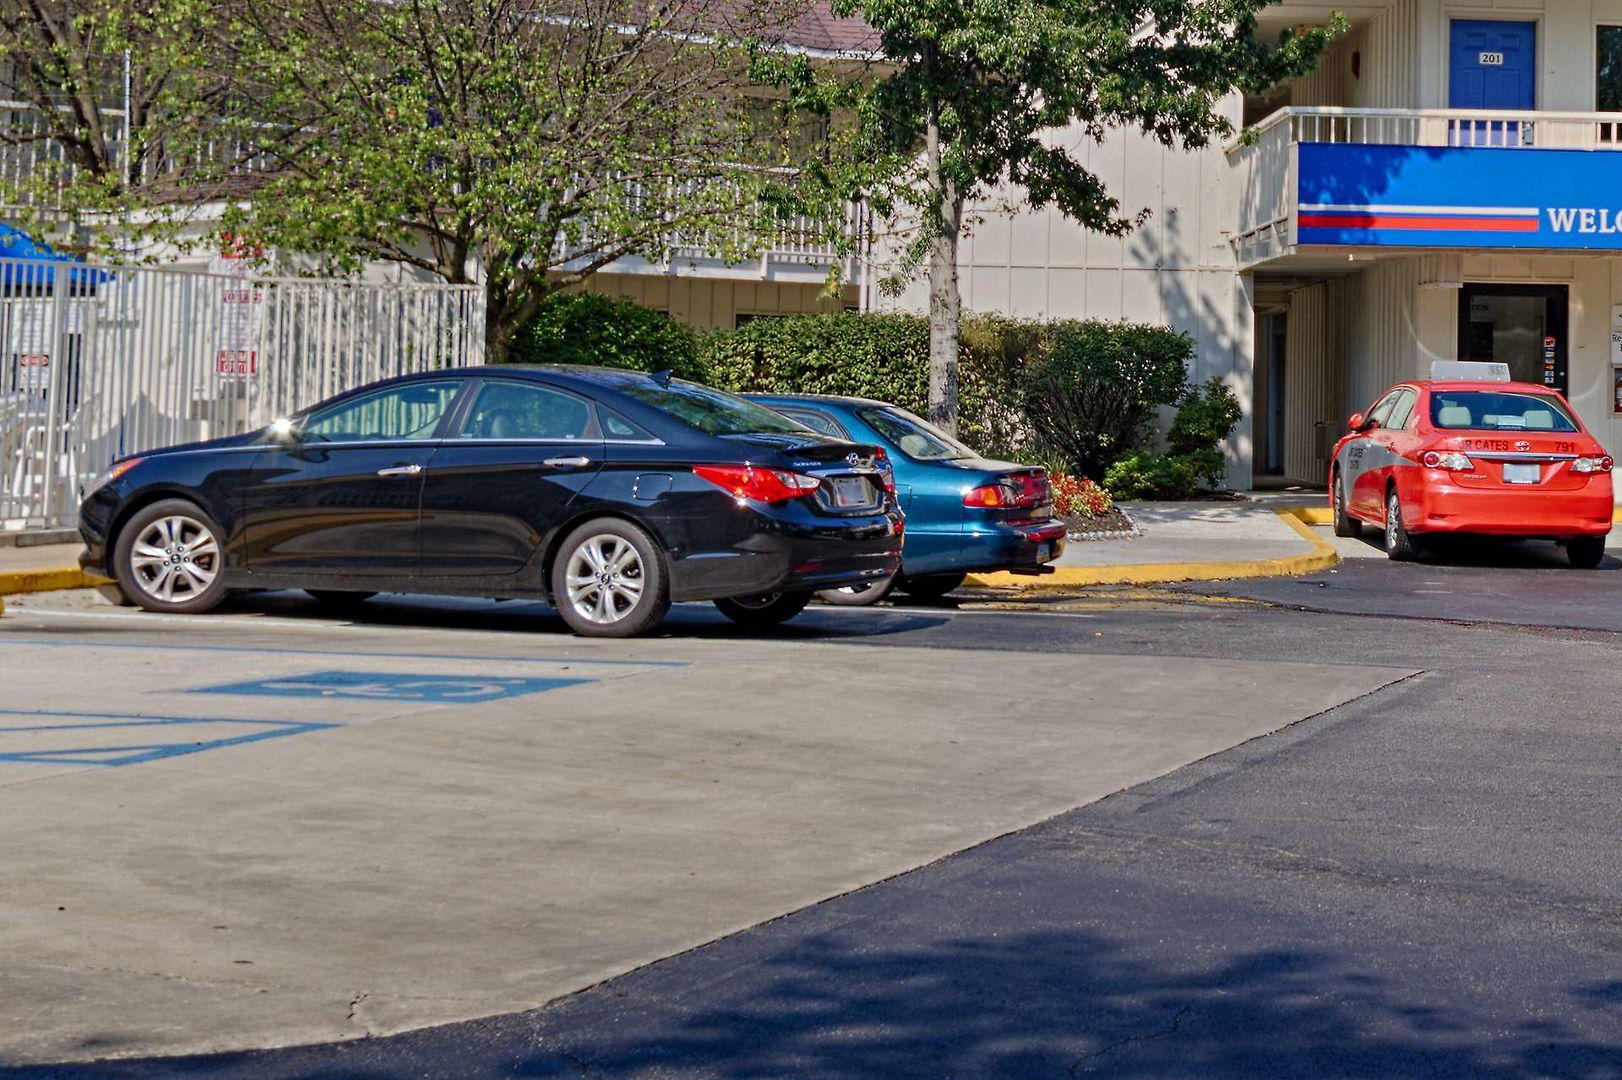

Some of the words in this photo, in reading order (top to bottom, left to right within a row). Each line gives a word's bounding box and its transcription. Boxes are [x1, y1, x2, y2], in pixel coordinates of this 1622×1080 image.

[1482, 53, 1500, 63] 201
[1475, 439, 1509, 451] CATES
[1554, 441, 1575, 452] 791
